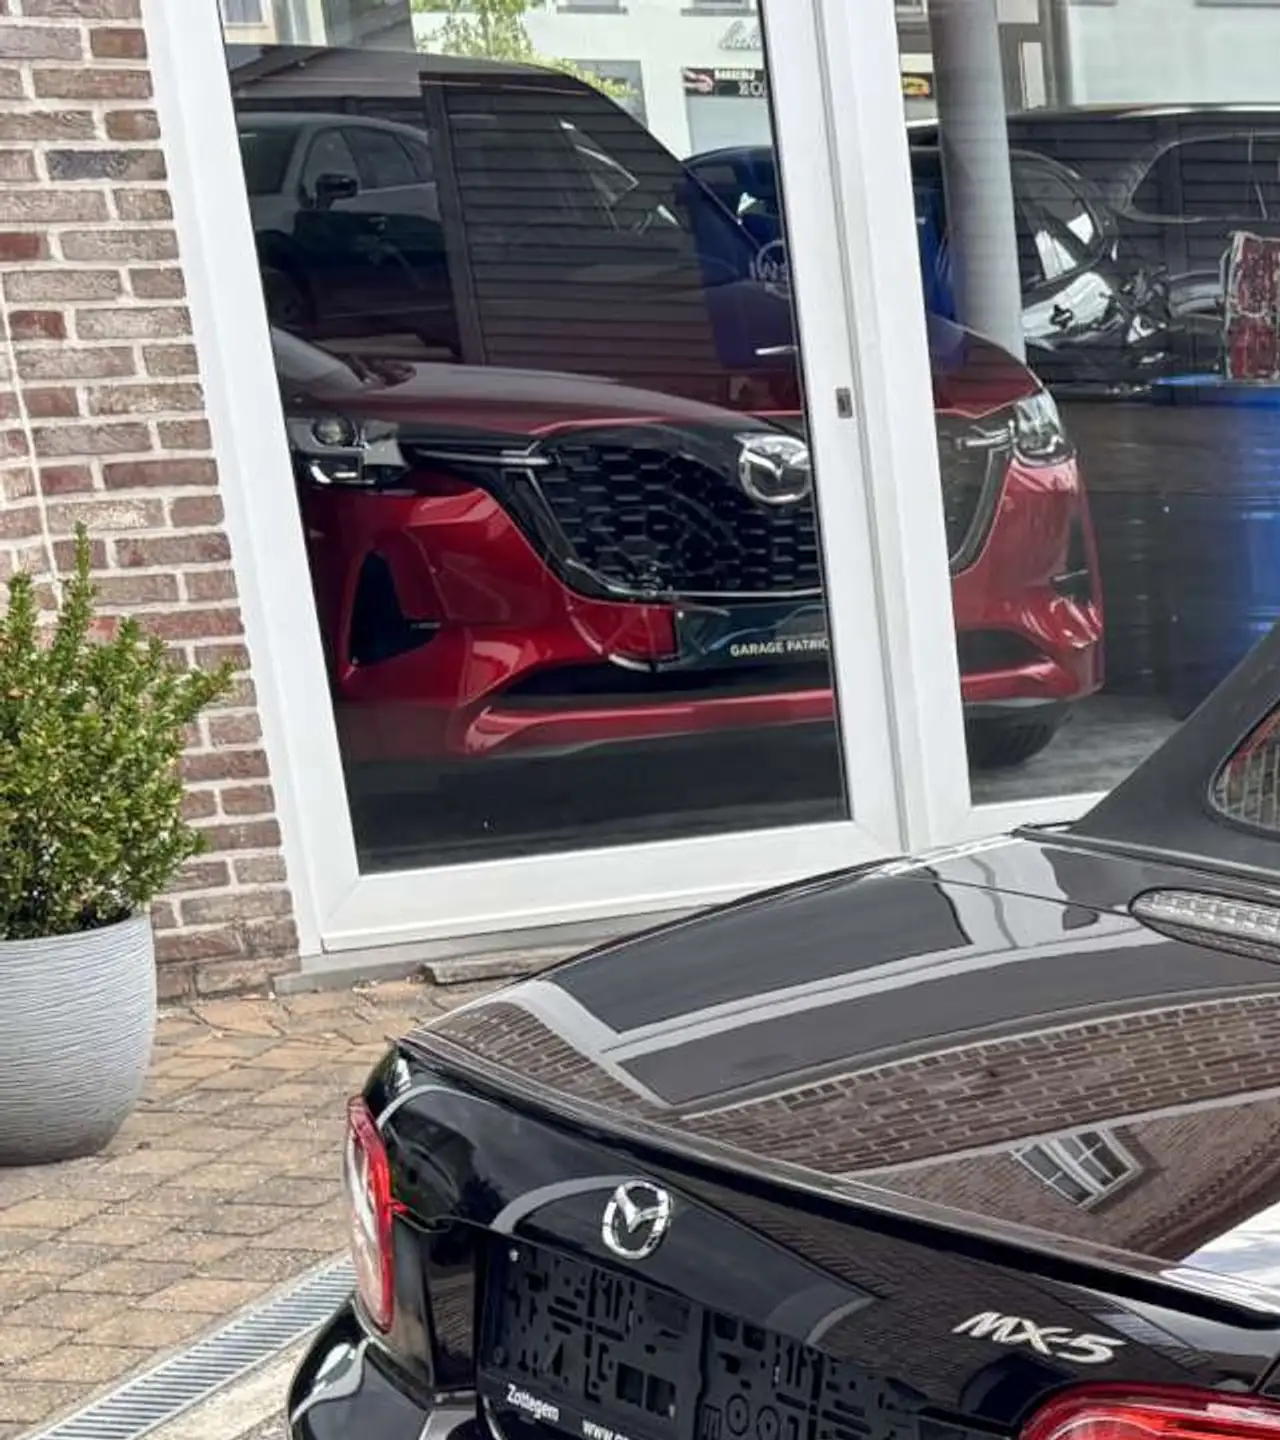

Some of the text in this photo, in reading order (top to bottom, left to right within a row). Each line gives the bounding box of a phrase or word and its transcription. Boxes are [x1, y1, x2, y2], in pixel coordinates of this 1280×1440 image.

[730, 642, 783, 657] GARAGE
[952, 1311, 1127, 1364] MX-5
[507, 1384, 559, 1421] Zottegem
